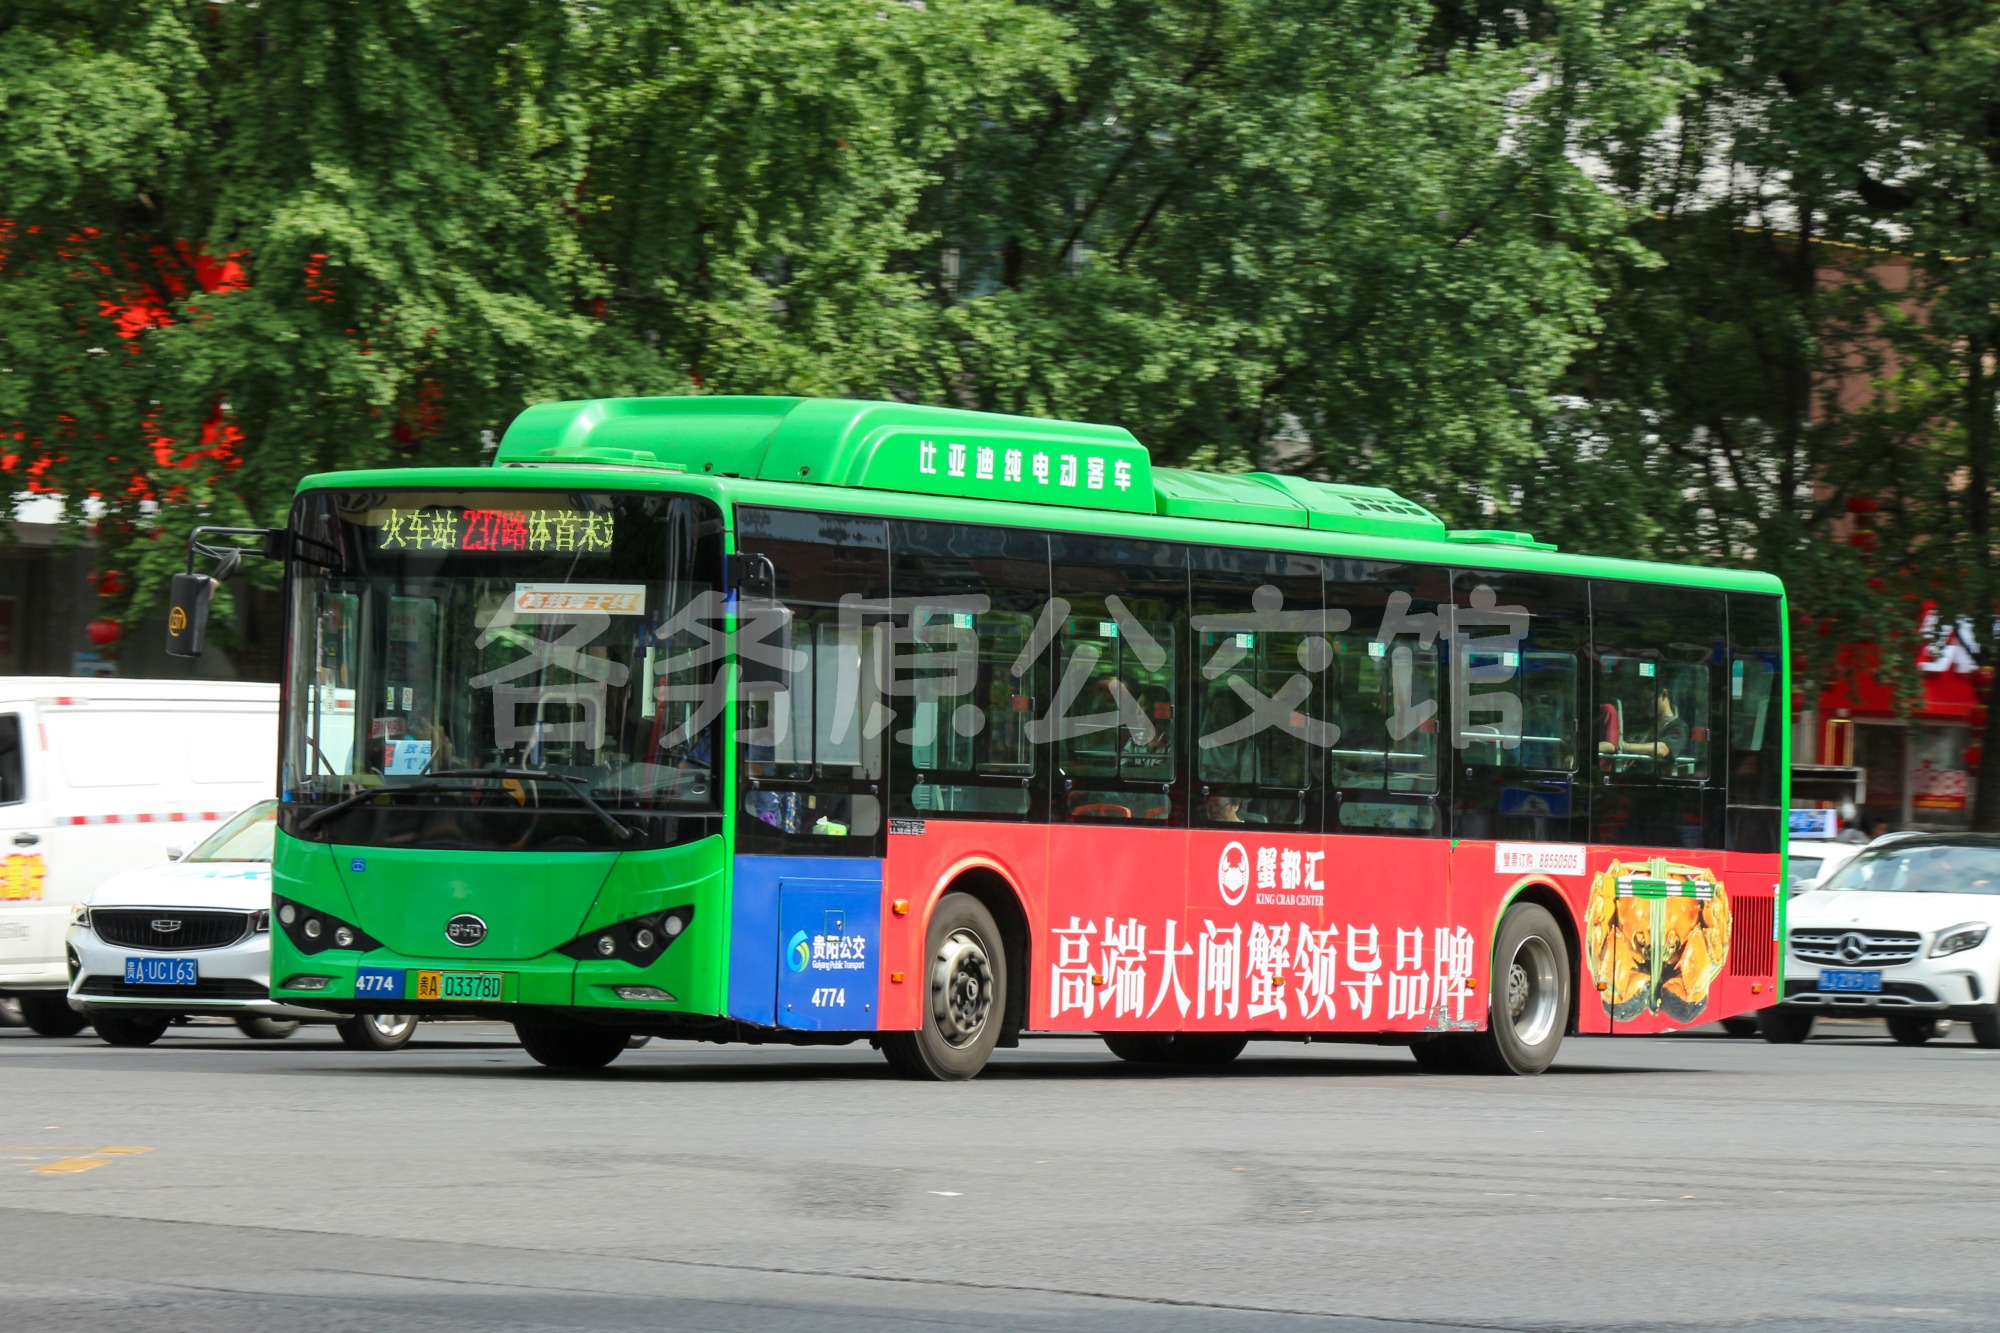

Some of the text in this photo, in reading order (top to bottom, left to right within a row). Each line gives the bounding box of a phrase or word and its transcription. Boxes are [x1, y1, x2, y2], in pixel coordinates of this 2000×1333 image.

[919, 439, 1131, 492] 比亚迪纯电动客车
[380, 508, 457, 550] 火车站
[462, 509, 528, 550] 237路
[1256, 846, 1325, 890] 蟹都汇
[1503, 852, 1577, 869] 蟹票订购 88550505
[1256, 893, 1324, 906] KING CRAB CENTER
[449, 923, 482, 937] BYD
[812, 934, 866, 960] 贵阳公交
[812, 960, 865, 971] Guiyang Public Transport
[1050, 916, 1475, 1021] 高端大闸蟹领导品牌
[355, 975, 393, 991] 4774
[811, 987, 845, 1007] 4774
